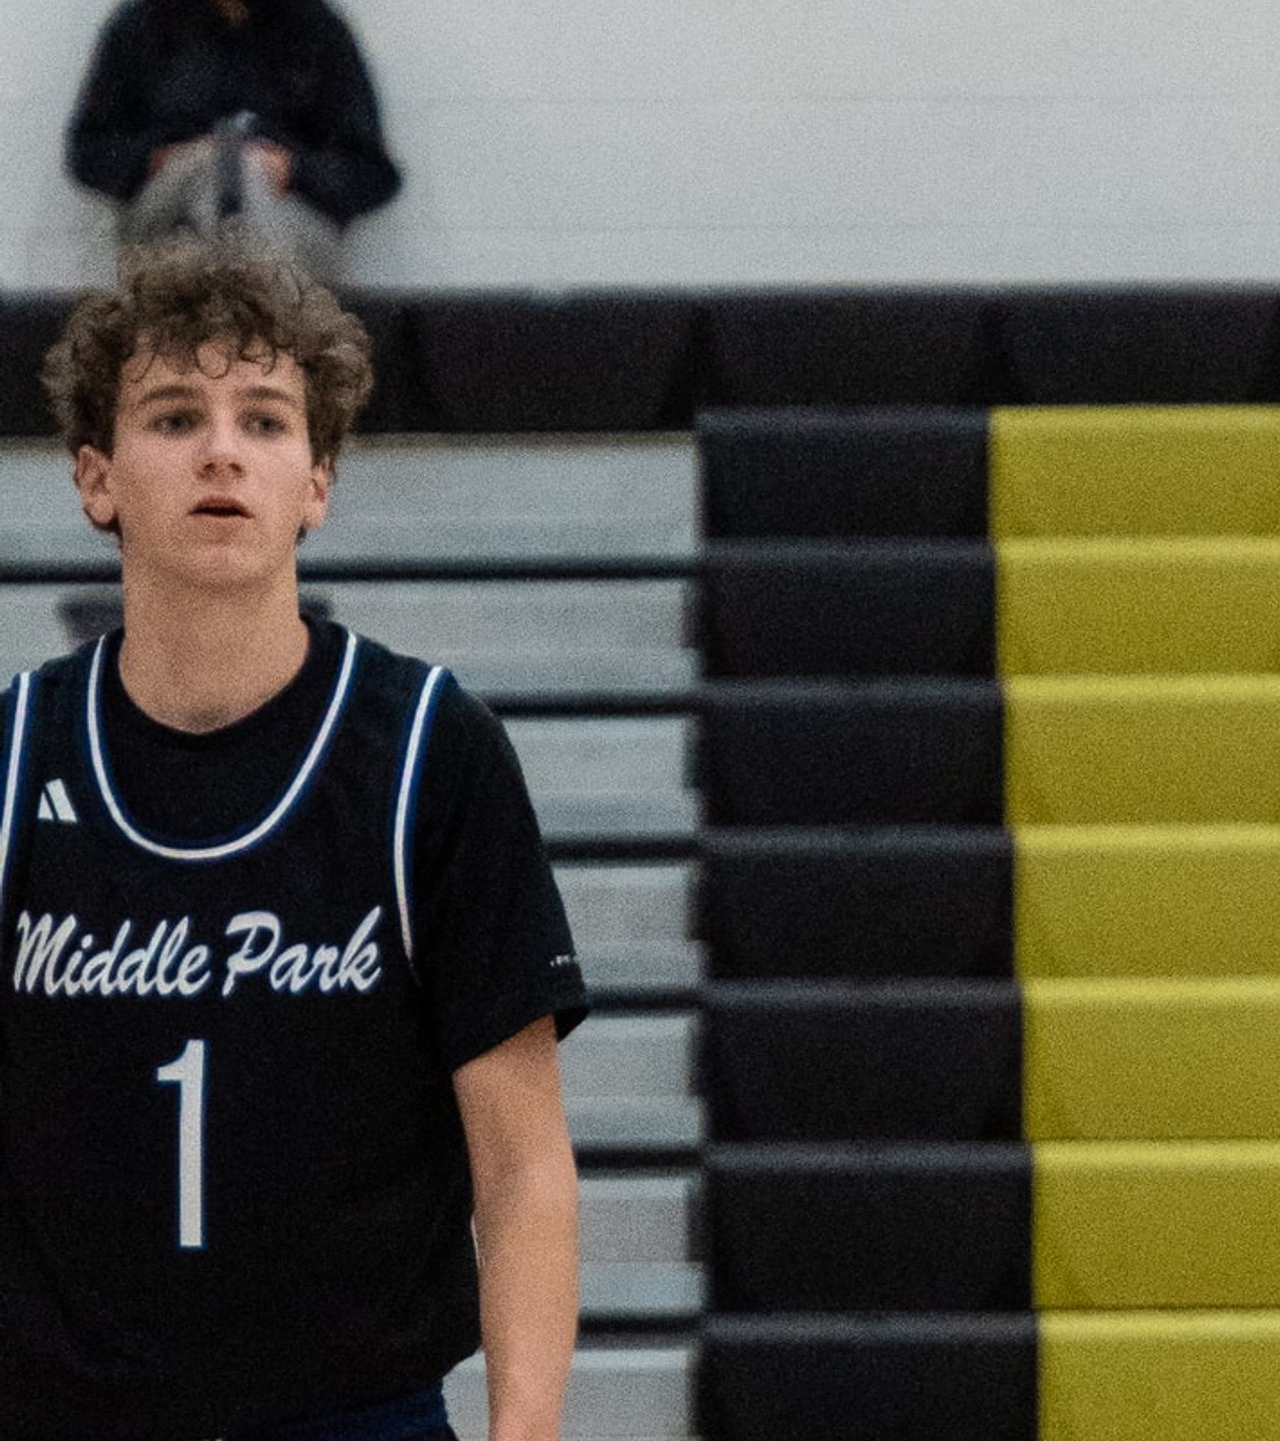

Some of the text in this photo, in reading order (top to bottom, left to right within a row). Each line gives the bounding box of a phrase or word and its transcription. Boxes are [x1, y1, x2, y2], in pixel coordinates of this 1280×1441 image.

[12, 905, 382, 997] Middle Park
[156, 1038, 206, 1249] 1
